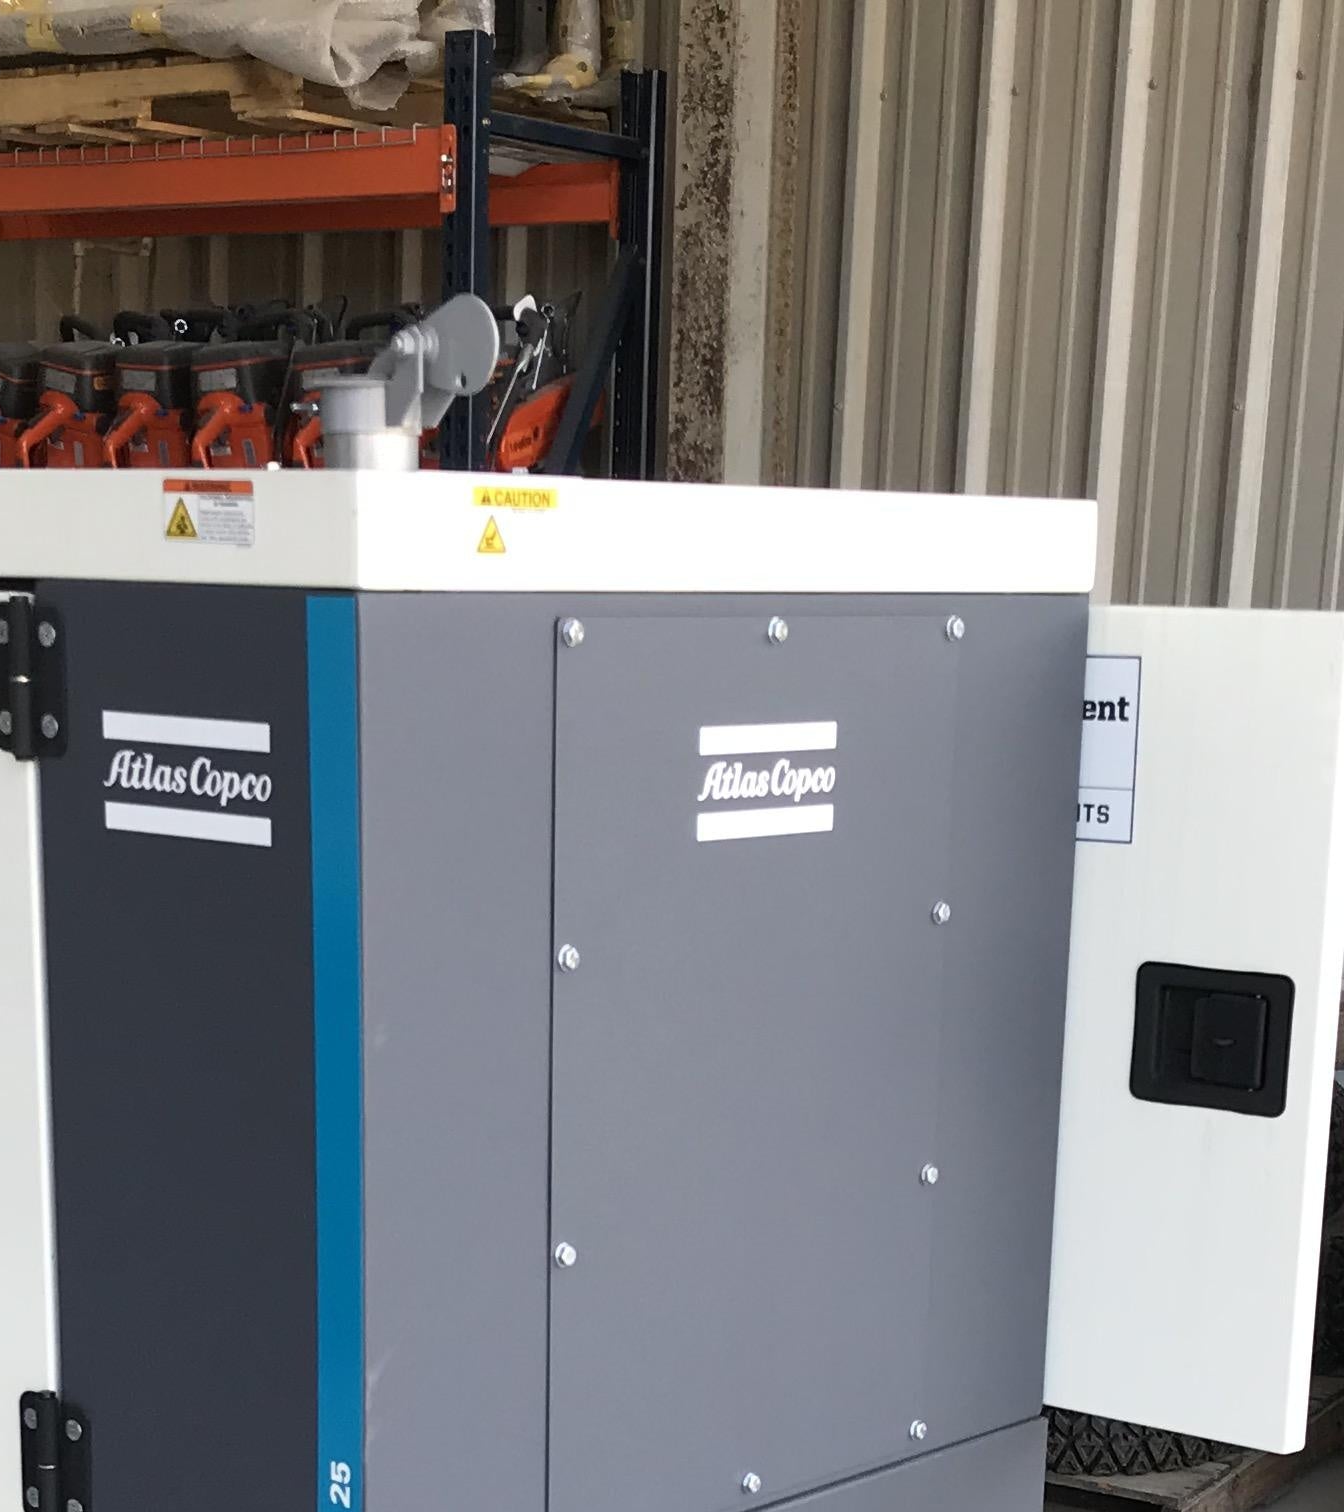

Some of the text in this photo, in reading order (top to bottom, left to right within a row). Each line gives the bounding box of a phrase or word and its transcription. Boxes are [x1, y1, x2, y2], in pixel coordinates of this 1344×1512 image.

[495, 490, 550, 508] CAUTION
[103, 749, 272, 807] Atlas Copco
[697, 758, 836, 803] Atlas Copco
[329, 1460, 351, 1509] 25
